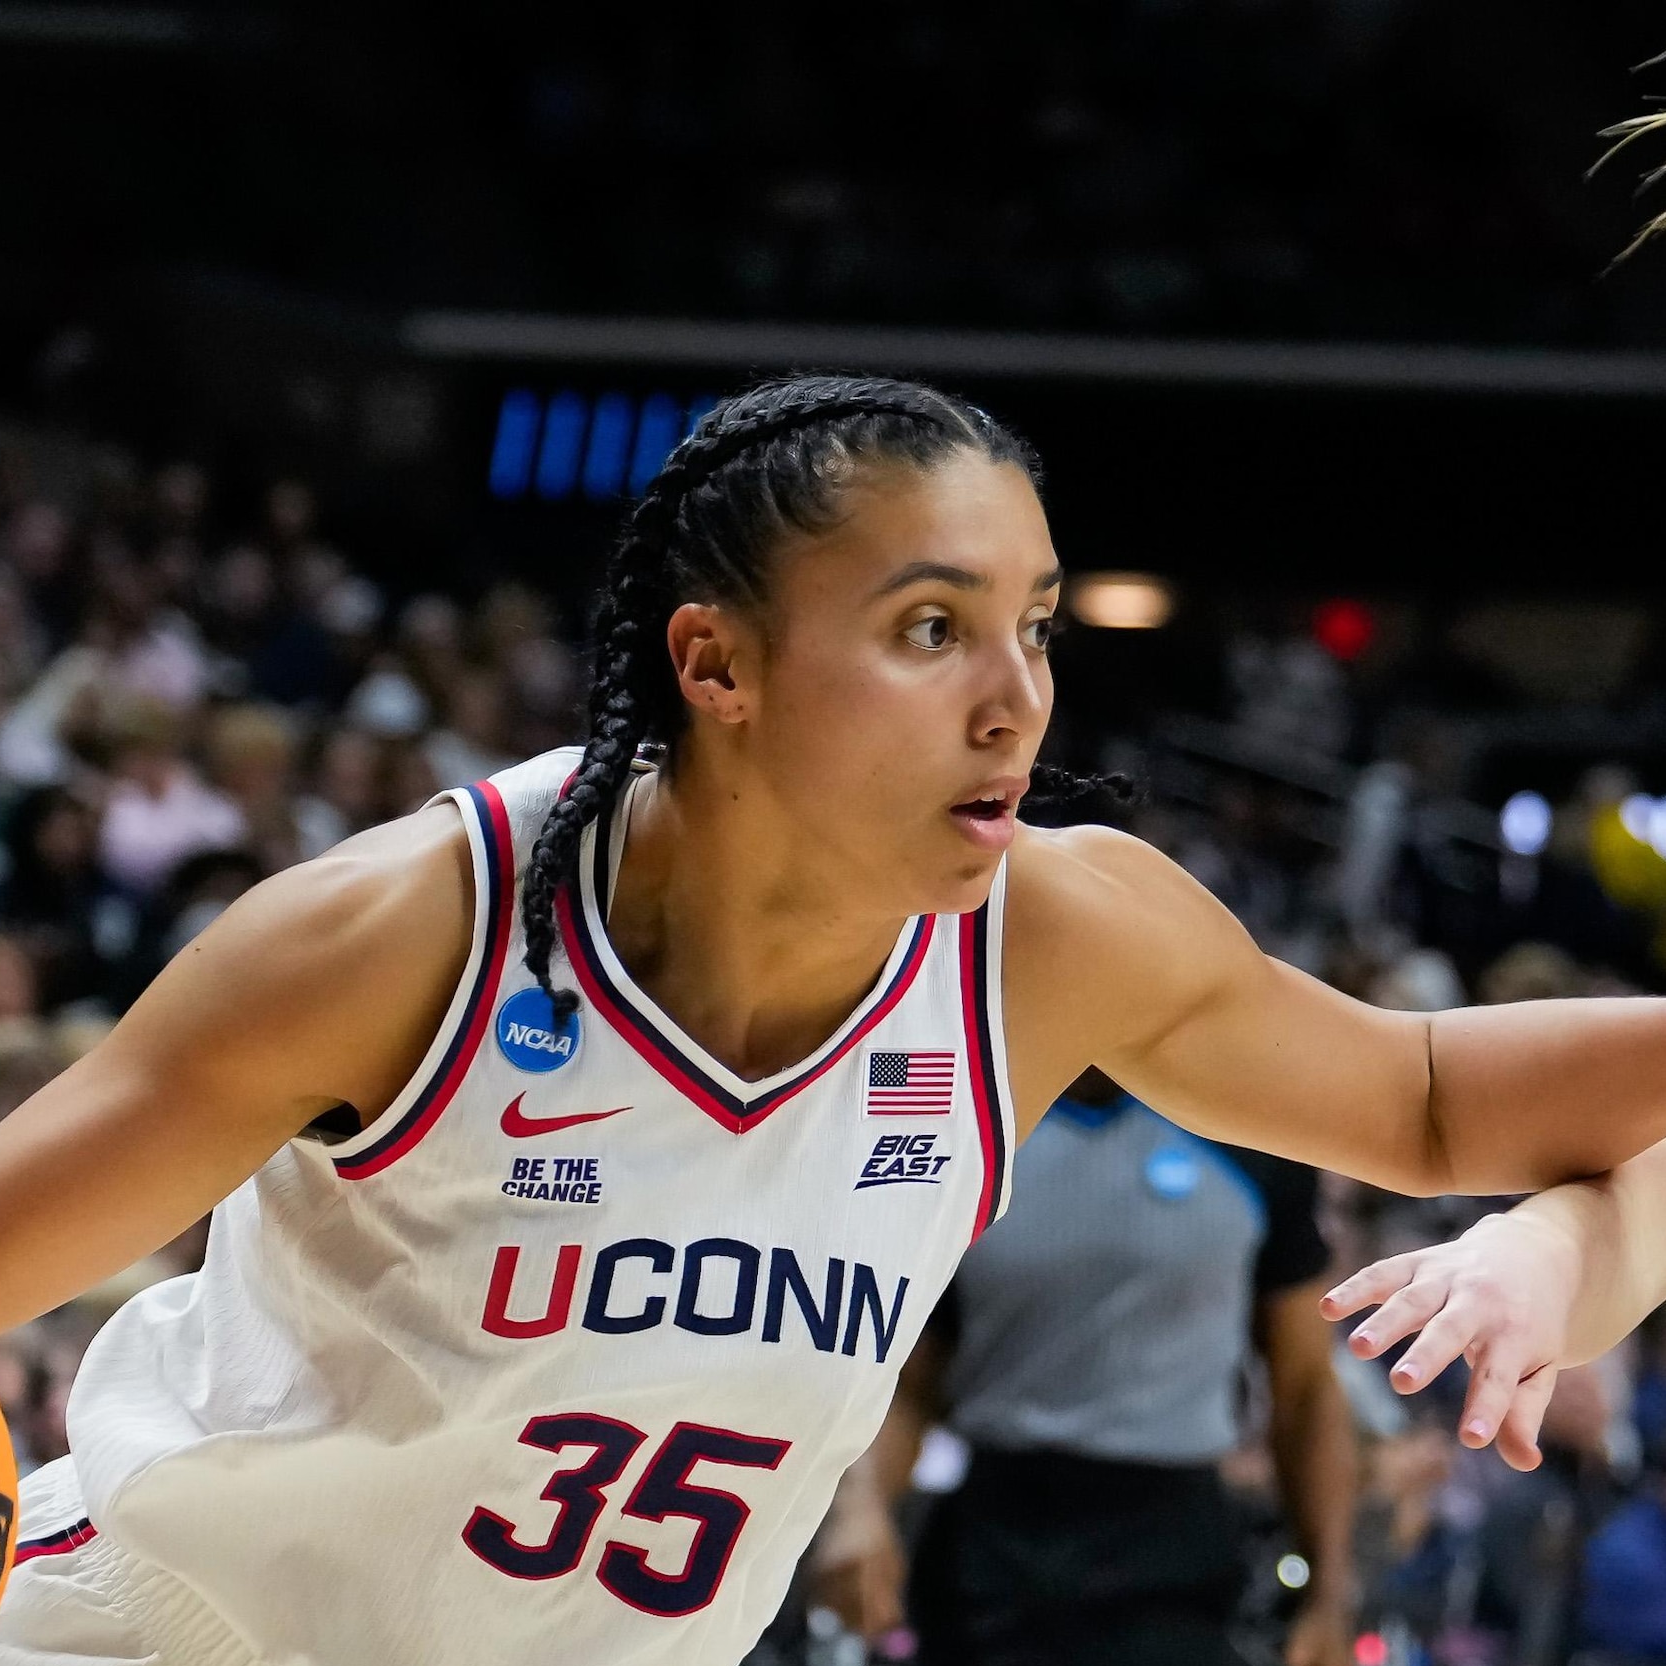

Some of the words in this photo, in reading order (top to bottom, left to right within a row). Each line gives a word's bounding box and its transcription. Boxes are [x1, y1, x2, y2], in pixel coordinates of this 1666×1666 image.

[506, 1022, 571, 1056] NCAA
[871, 1134, 938, 1156] BIG
[512, 1157, 545, 1181] BE
[553, 1157, 598, 1181] THE
[859, 1155, 952, 1178] EAST
[501, 1181, 601, 1203] CHANGE
[481, 1237, 910, 1363] UCONN
[461, 1412, 793, 1618] 35
